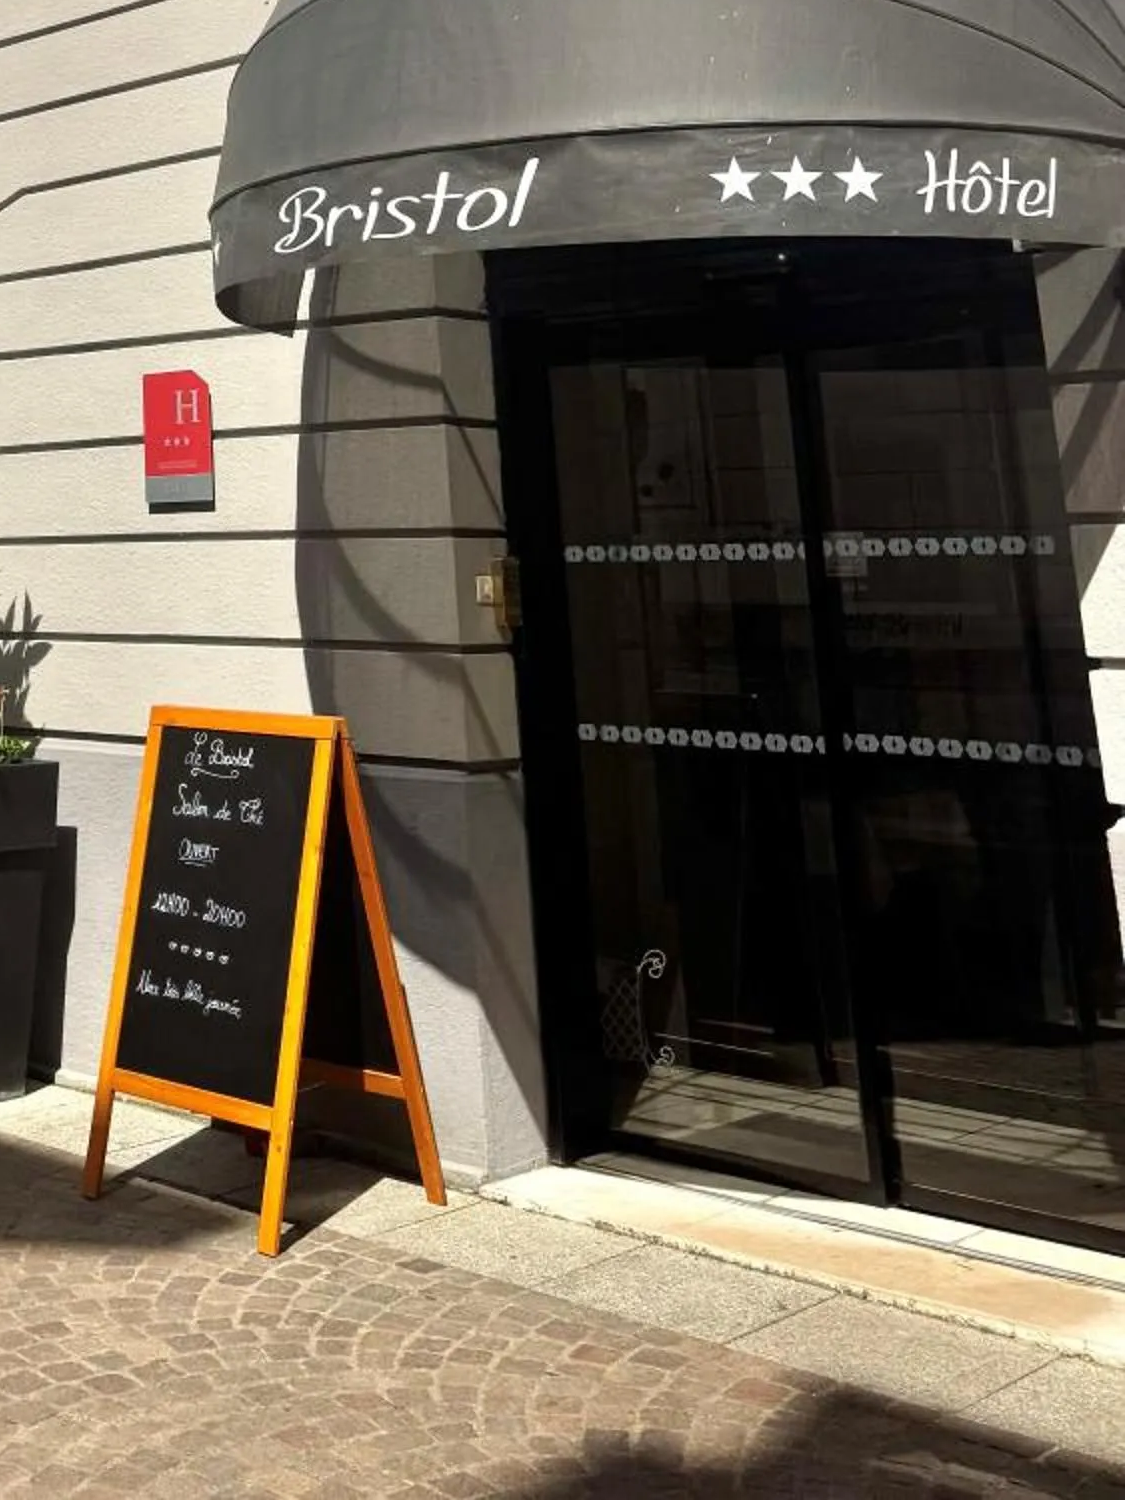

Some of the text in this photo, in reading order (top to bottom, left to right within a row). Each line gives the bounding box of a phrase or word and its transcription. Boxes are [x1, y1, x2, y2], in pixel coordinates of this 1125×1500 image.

[273, 147, 1058, 255] Bristol Hôtel
[173, 388, 202, 425] H
